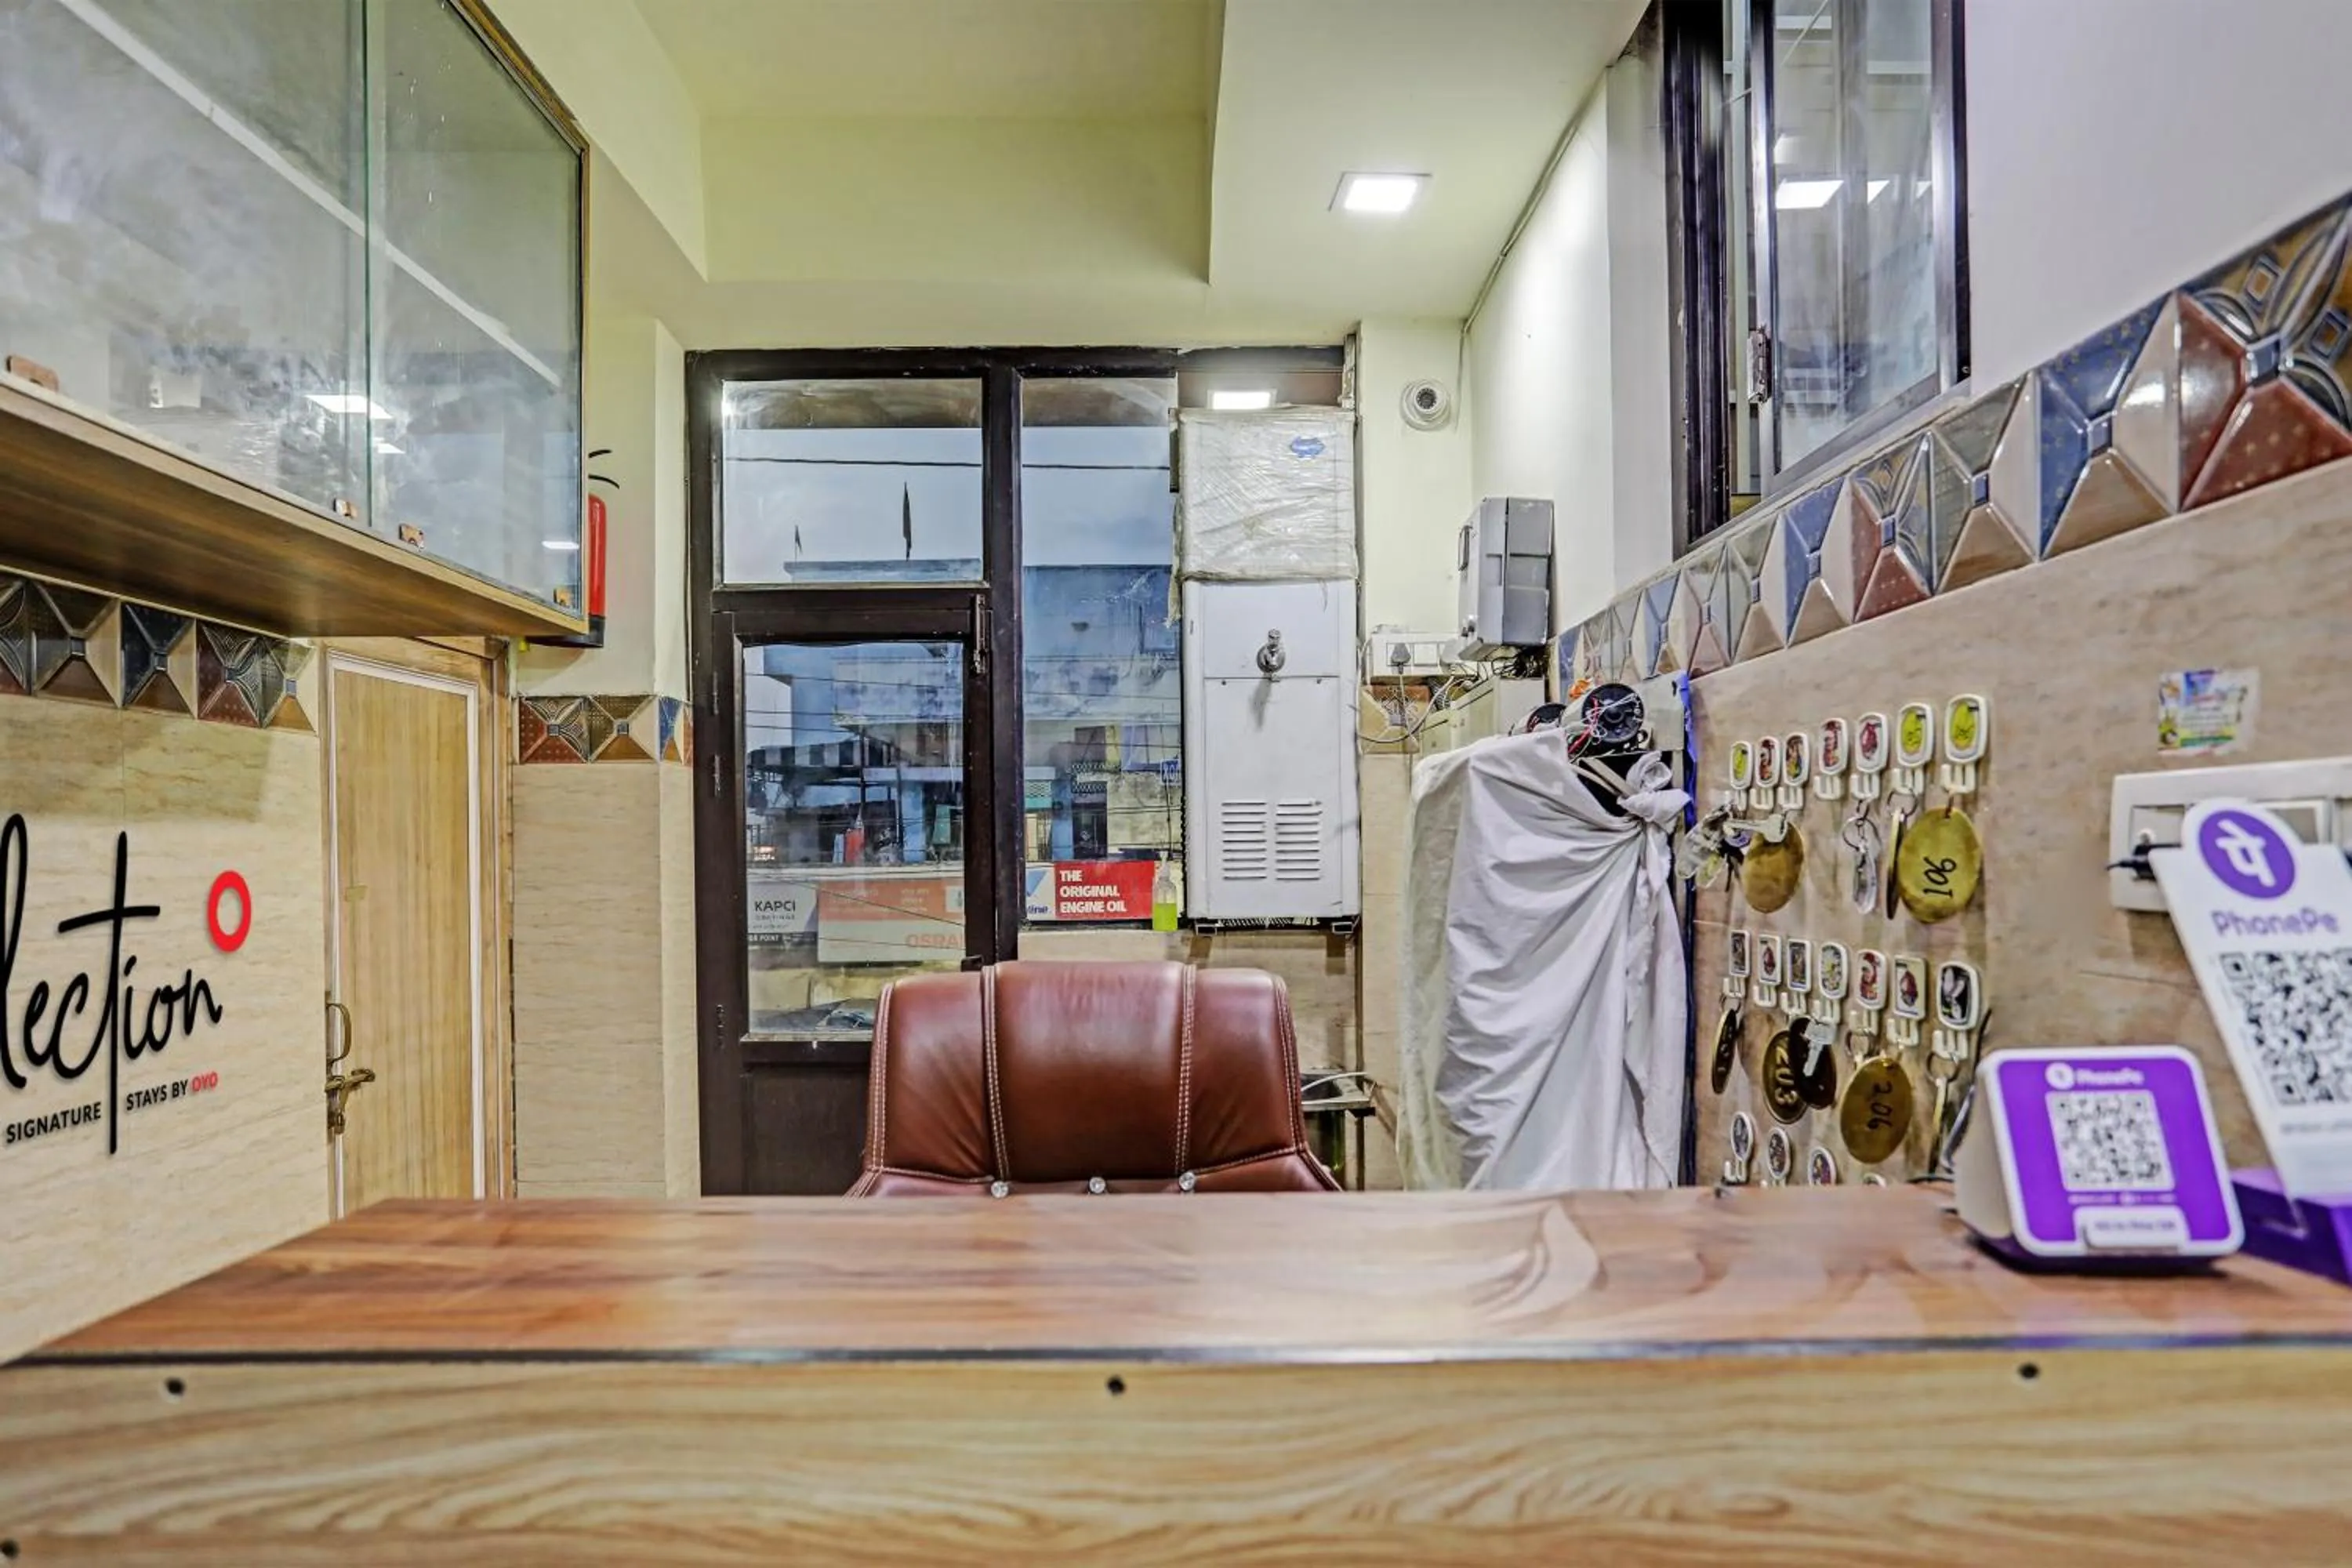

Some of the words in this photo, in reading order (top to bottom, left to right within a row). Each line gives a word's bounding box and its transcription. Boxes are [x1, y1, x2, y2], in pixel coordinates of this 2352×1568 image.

[1060, 870, 1083, 882] THE
[1922, 856, 1957, 898] 106
[1060, 885, 1120, 898] ORIGINAL
[755, 901, 796, 912] KAPCI
[1061, 901, 1105, 913] ENGINE
[1106, 900, 1127, 912] OIL
[2211, 907, 2339, 937] PhonePe
[6, 1102, 102, 1144] SIGNATURE
[125, 1084, 168, 1111] STAYS
[171, 1079, 189, 1098] BY
[191, 1071, 219, 1092] OYO
[1868, 1080, 1893, 1129] 206
